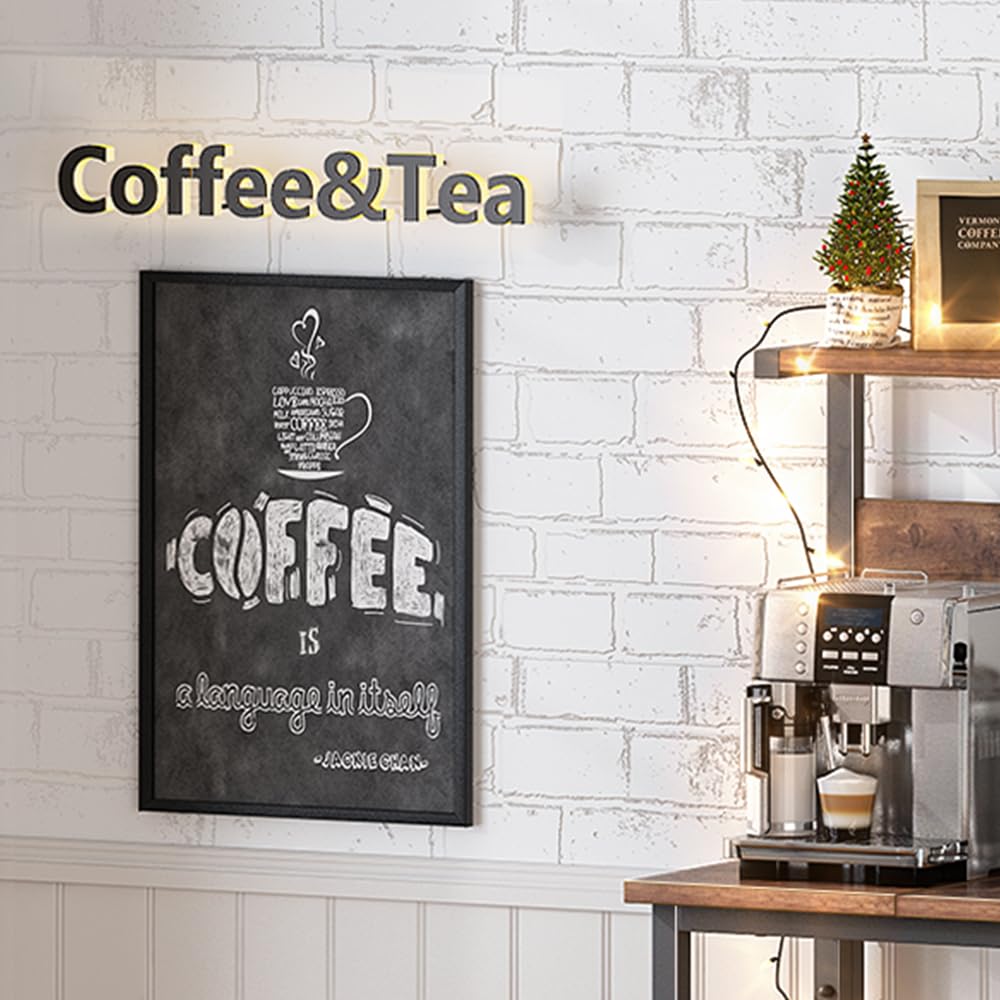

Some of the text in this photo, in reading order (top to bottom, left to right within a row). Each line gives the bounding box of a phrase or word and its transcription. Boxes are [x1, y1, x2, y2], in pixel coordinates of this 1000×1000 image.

[58, 143, 527, 225] Coffee&Tea
[177, 498, 434, 618] COFFEE
[299, 626, 321, 656] IS
[175, 671, 442, 740] a language in itself
